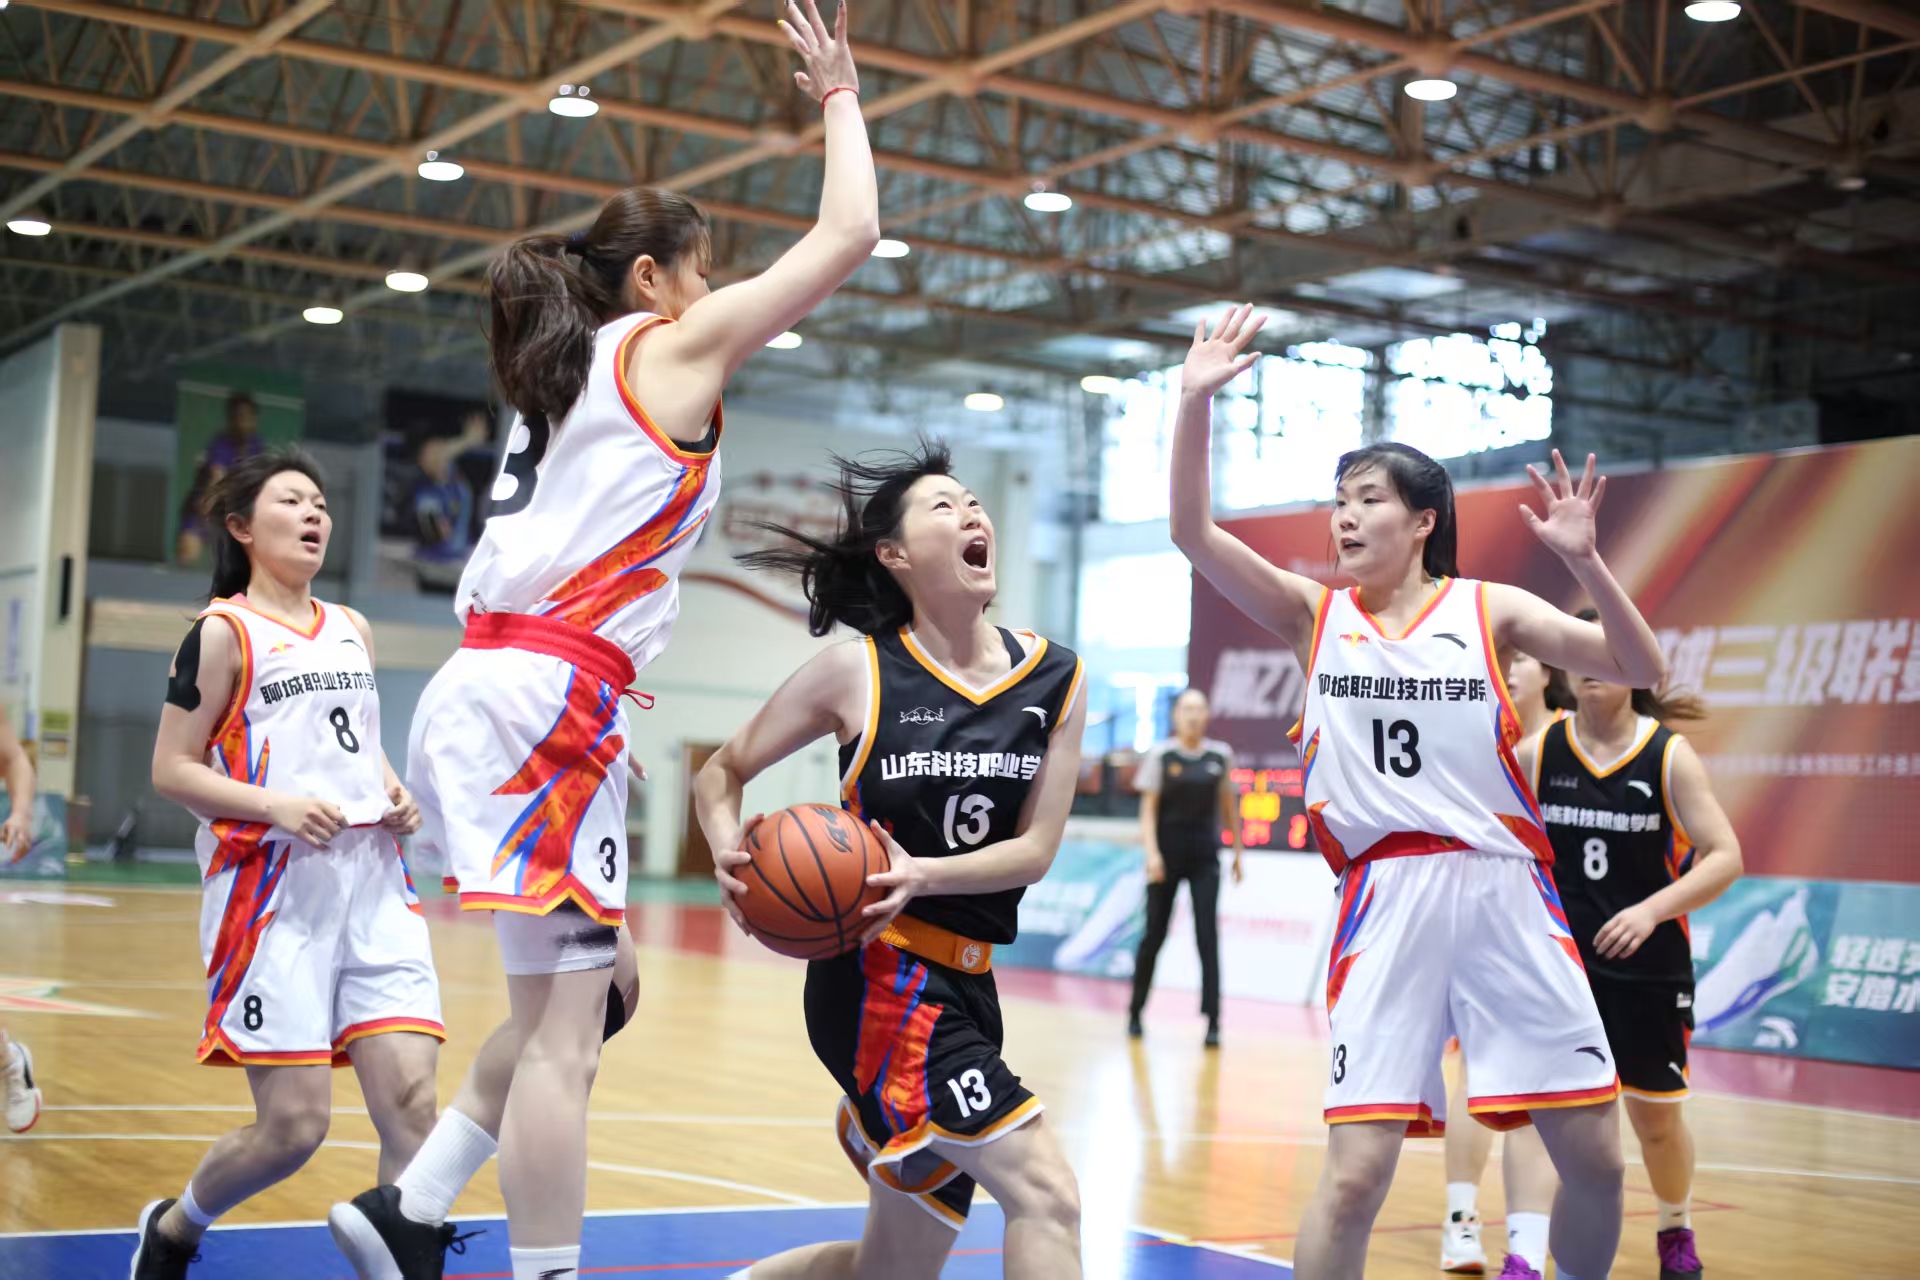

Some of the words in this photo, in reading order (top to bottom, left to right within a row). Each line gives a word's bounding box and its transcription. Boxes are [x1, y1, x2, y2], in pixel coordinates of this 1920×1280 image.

[329, 706, 360, 754] 8
[1372, 718, 1422, 778] 13
[943, 793, 996, 850] 13
[599, 836, 617, 884] 3
[1583, 837, 1609, 881] 8
[243, 994, 264, 1032] 8
[946, 1067, 992, 1119] 13
